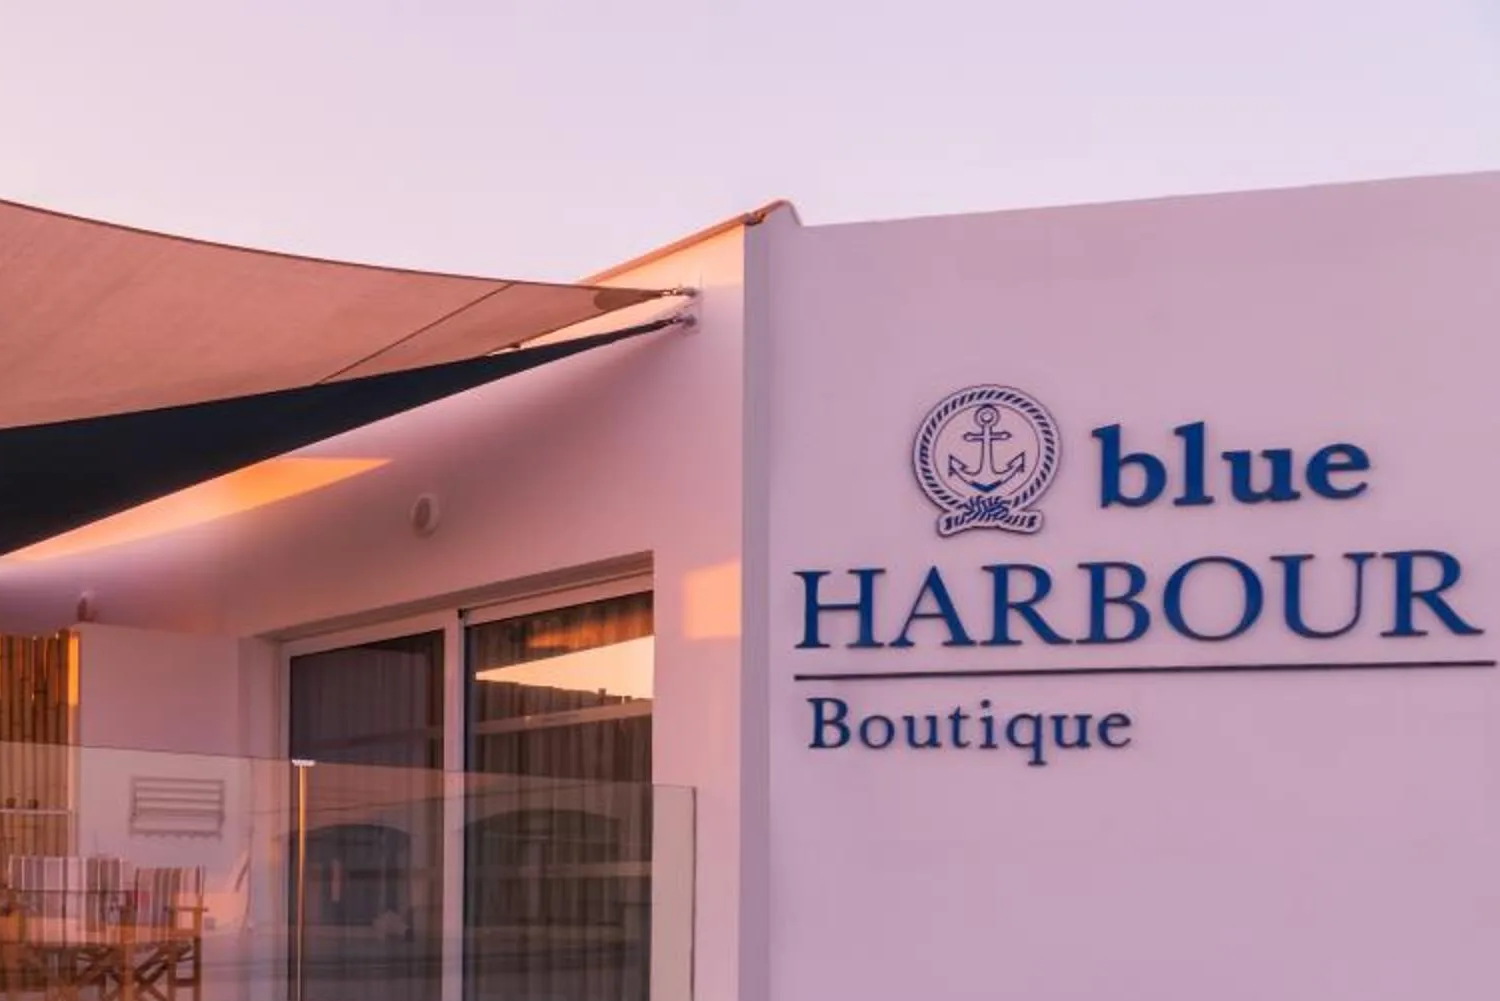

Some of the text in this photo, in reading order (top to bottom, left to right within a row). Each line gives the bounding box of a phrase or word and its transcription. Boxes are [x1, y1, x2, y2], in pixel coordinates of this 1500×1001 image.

[1090, 420, 1372, 510] blue
[792, 549, 1485, 651] HARBOUR
[805, 696, 1134, 769] Boutique
